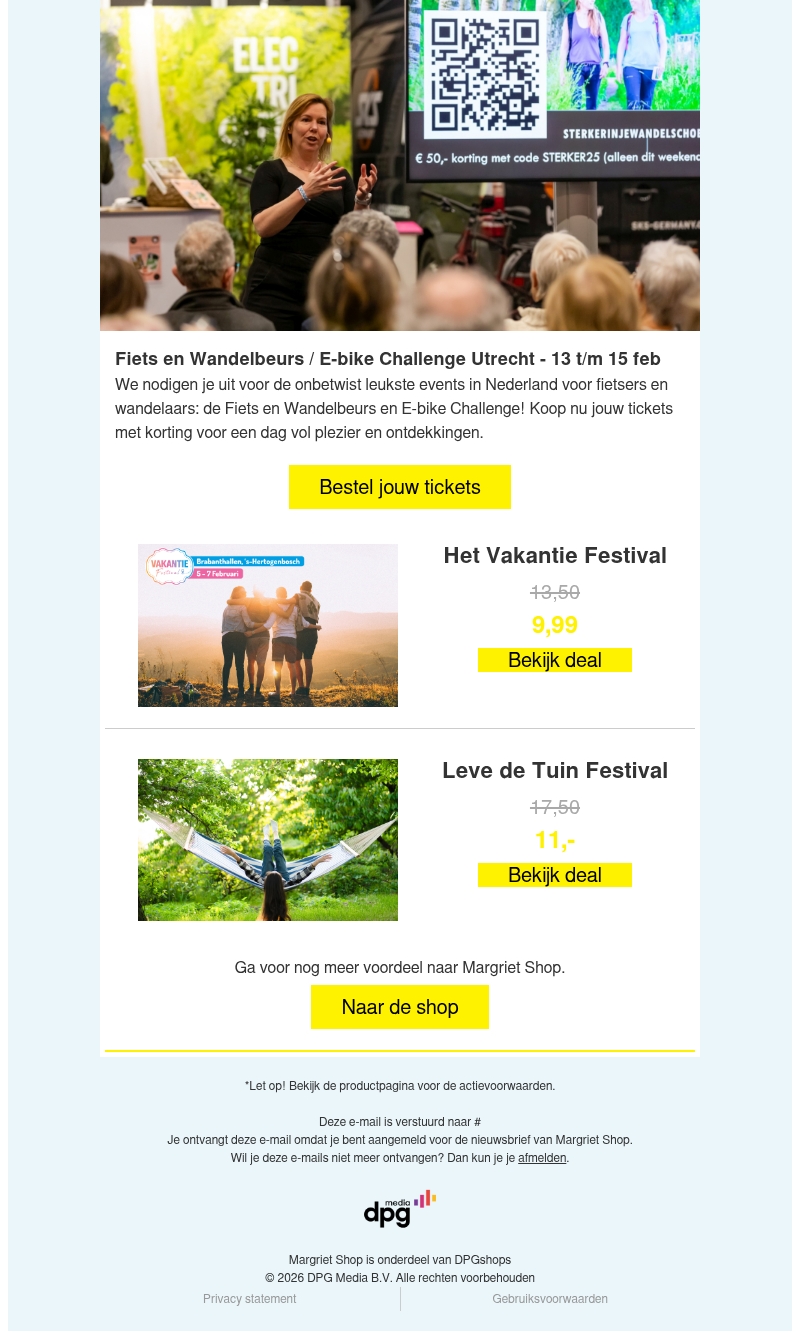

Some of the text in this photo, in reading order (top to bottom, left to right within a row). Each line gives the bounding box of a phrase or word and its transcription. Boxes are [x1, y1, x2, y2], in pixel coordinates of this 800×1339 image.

[233, 36, 299, 73] ELEC
[415, 153, 423, 164] €
[426, 153, 448, 165] 50,-
[451, 152, 488, 165] korting
[491, 154, 511, 163] met
[514, 152, 540, 163] code
[542, 151, 600, 163] STERKER25
[603, 151, 639, 164] (alleen
[641, 152, 655, 162] dit
[116, 352, 660, 369] Fiets en Wandelbeurs E-bike Challenge Utrecht 13 t/m 15 feb
[320, 478, 480, 499] Bestel jouw tickets
[445, 547, 666, 564] Het Vakantie Festival
[530, 585, 580, 602] 13,50
[532, 616, 578, 638] 9,99
[509, 652, 601, 672] Bekijk deal
[444, 762, 667, 779] Leve de Tuin Festival
[530, 800, 580, 817] 17,50
[536, 830, 575, 852] 11,-
[509, 866, 601, 887] Bekijk deal
[235, 961, 564, 976] Ga voor nog meer voordeel naar Margriet Shop.
[342, 999, 458, 1018] Naar de shop
[269, 1081, 285, 1092] op!
[290, 1081, 320, 1093] Bekijk
[323, 1081, 336, 1090] de
[340, 1081, 414, 1092] productpagina
[443, 1081, 456, 1090] de
[460, 1081, 555, 1090] actievoorwaarden.
[364, 1201, 411, 1228] dpg
[289, 1255, 332, 1266] Margriet
[336, 1255, 363, 1266] Shop
[367, 1255, 374, 1264] is
[378, 1255, 429, 1264] onderdeel
[455, 1255, 511, 1266] DPGshops
[204, 1294, 296, 1306] Privacy statement
[493, 1294, 607, 1303] Gebruiksvoorwaarden
